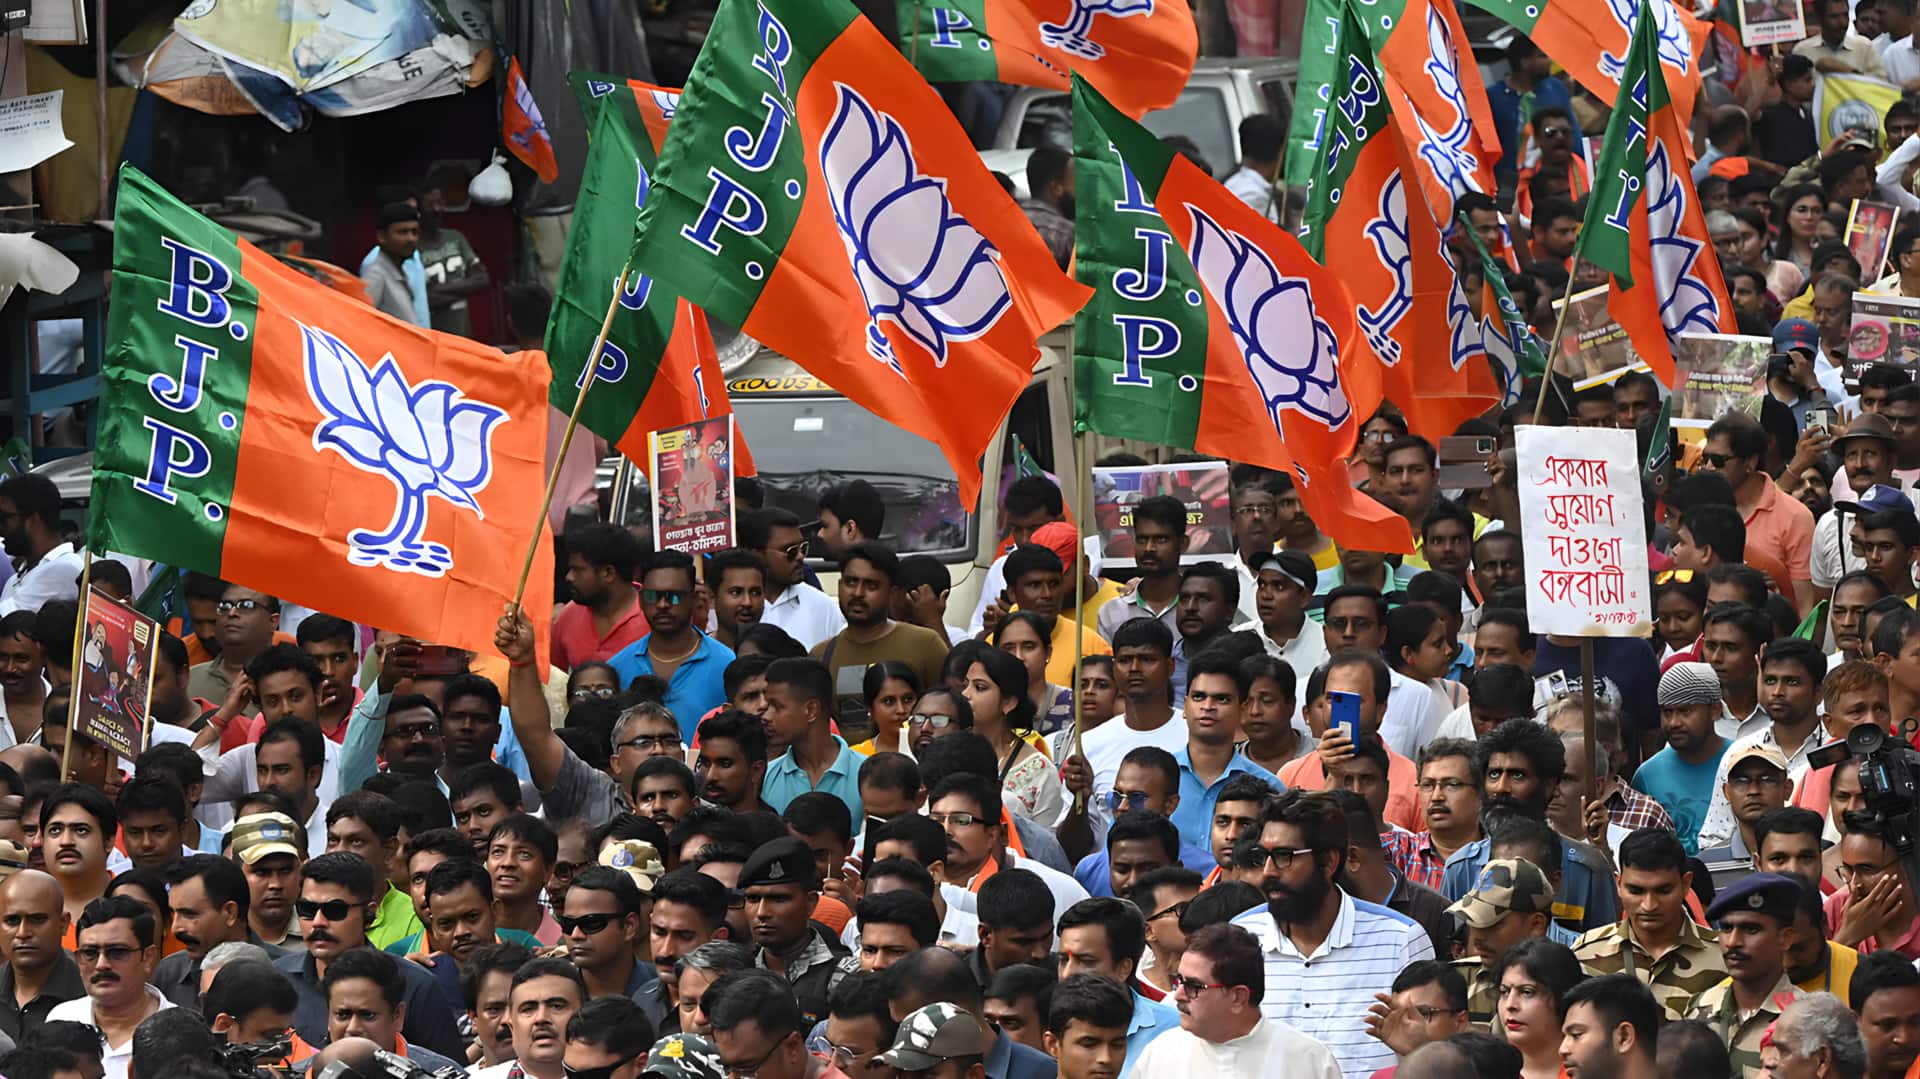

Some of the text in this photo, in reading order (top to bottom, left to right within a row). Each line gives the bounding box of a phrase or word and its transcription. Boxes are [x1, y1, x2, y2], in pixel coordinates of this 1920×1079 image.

[1532, 454, 1609, 488] একবার
[1544, 494, 1615, 533] সুযোগ
[1548, 535, 1623, 568] দাওগো
[1539, 565, 1625, 608] বঙ্গবাসী
